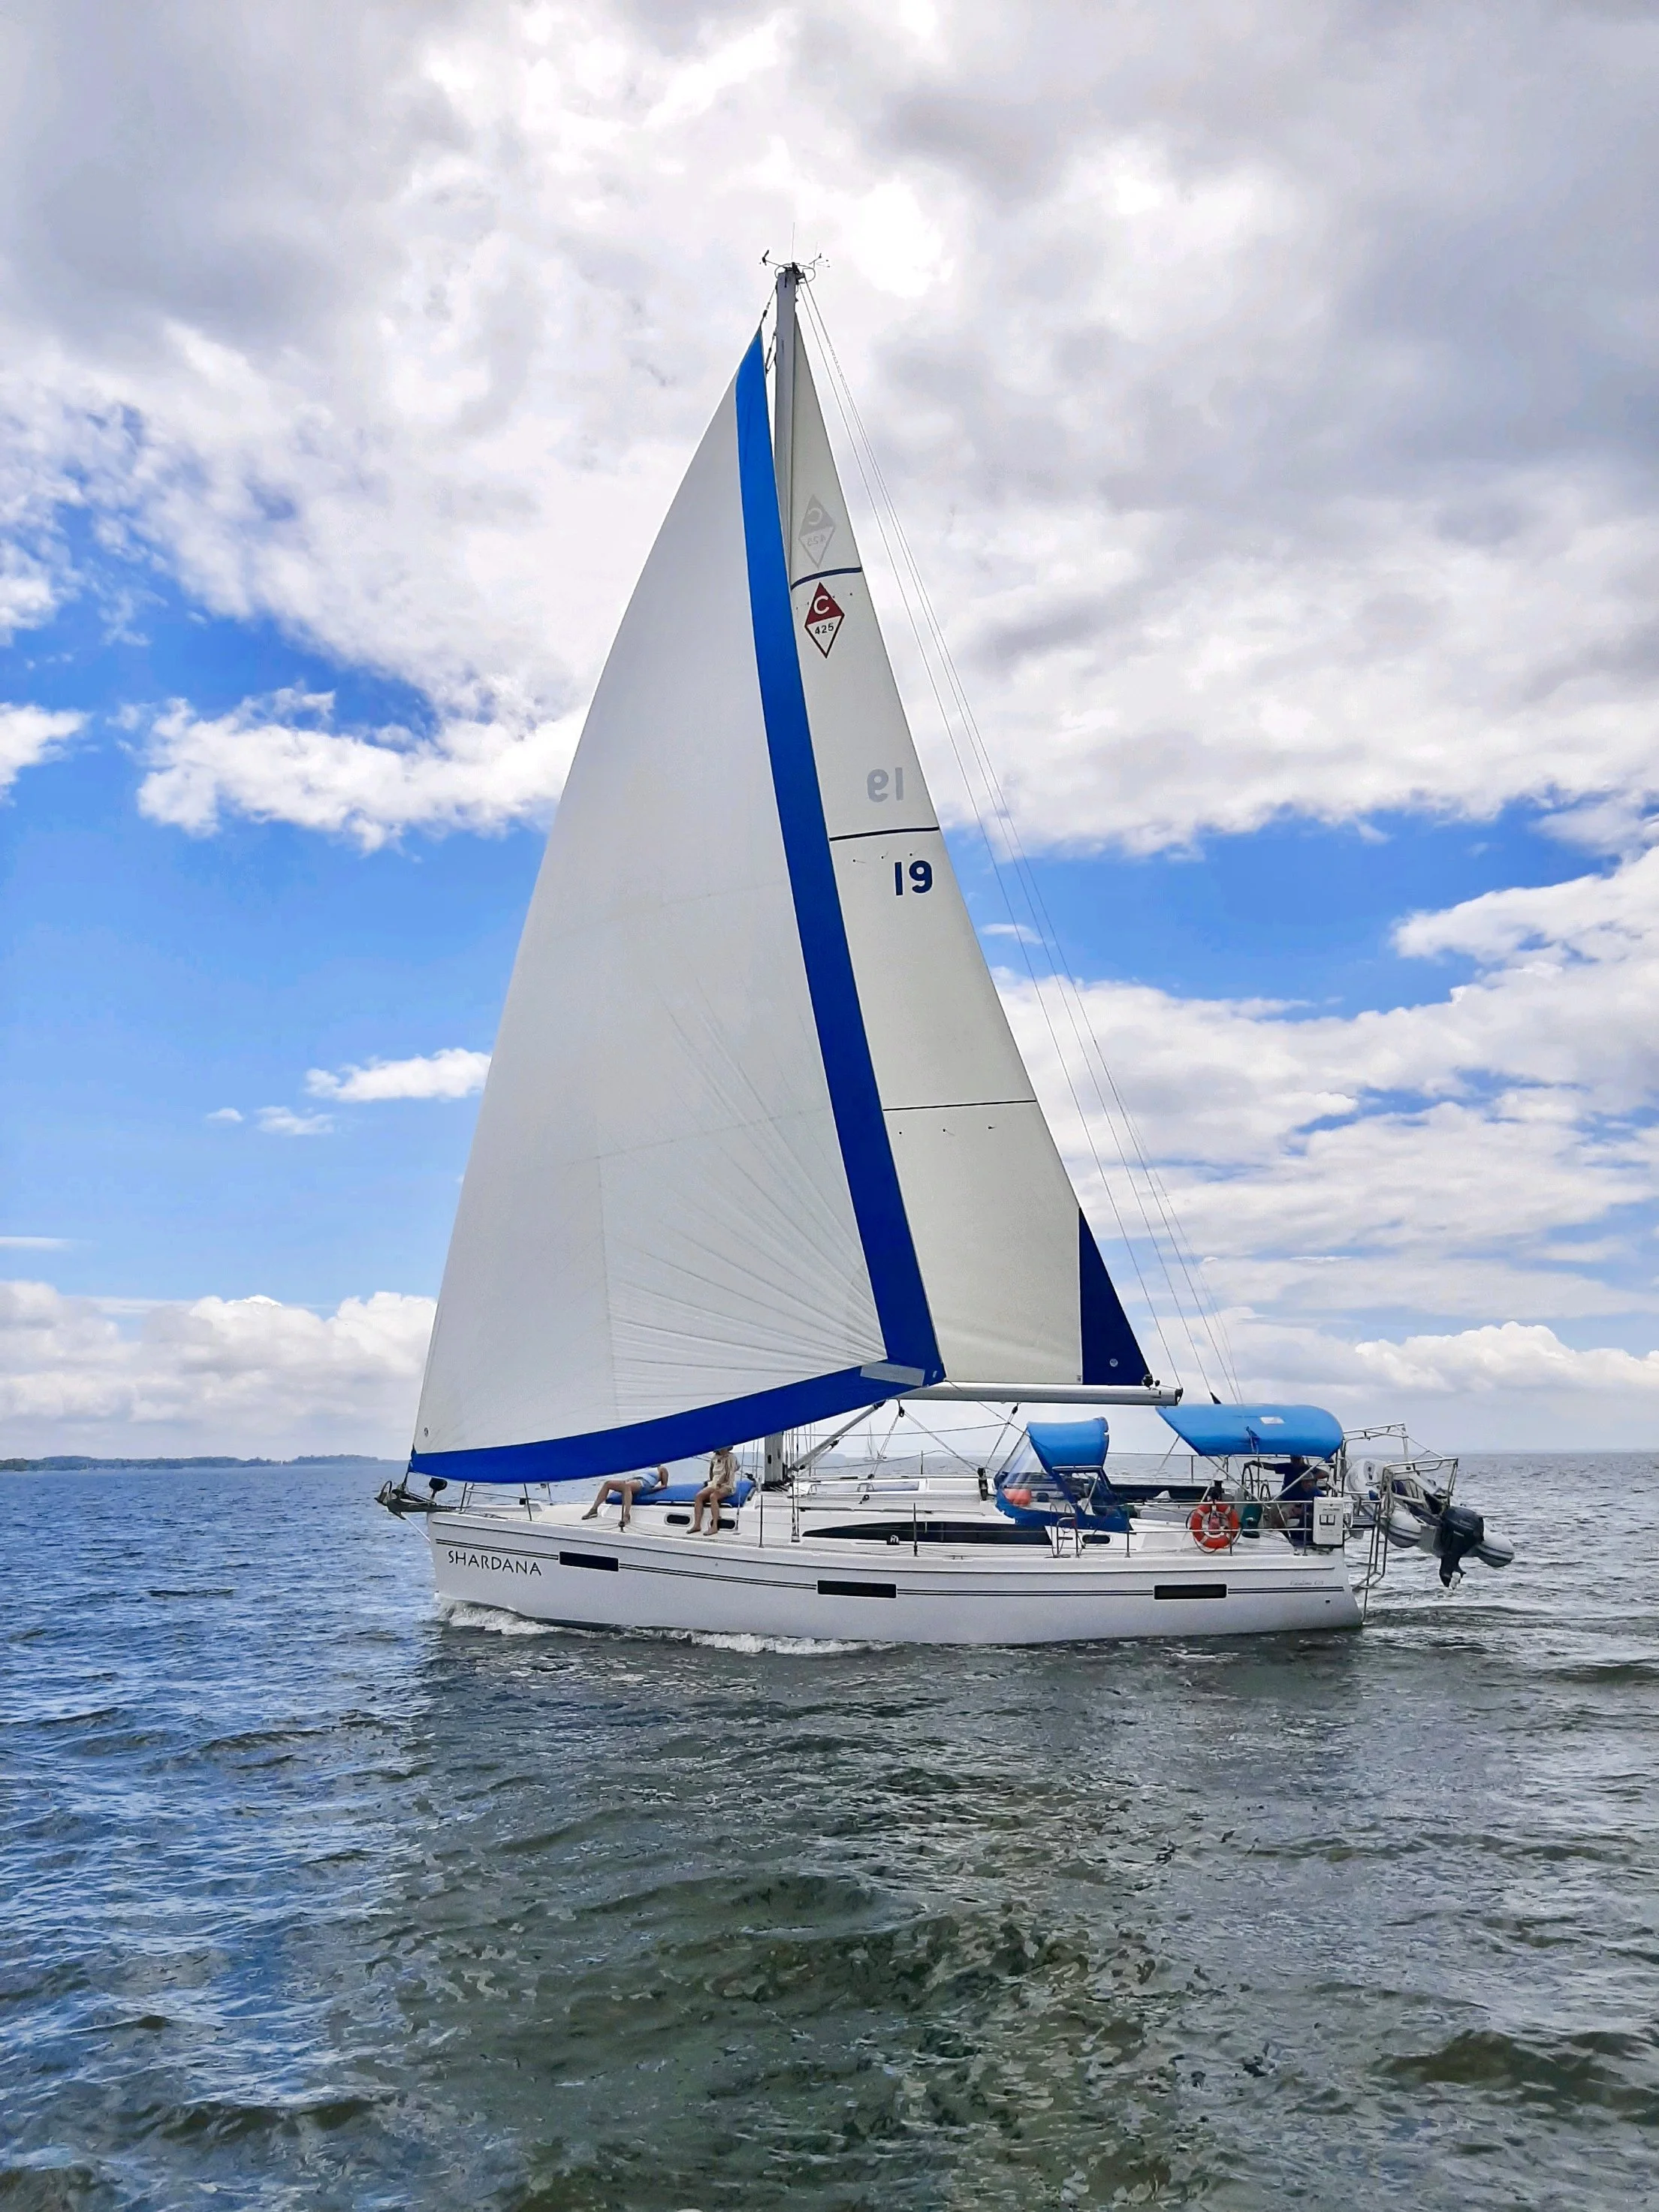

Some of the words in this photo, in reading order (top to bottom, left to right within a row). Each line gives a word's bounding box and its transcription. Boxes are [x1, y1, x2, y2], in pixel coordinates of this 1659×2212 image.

[813, 595, 830, 614] C
[815, 623, 834, 635] 425
[894, 860, 933, 896] 19
[448, 1550, 542, 1577] SHARDANA
